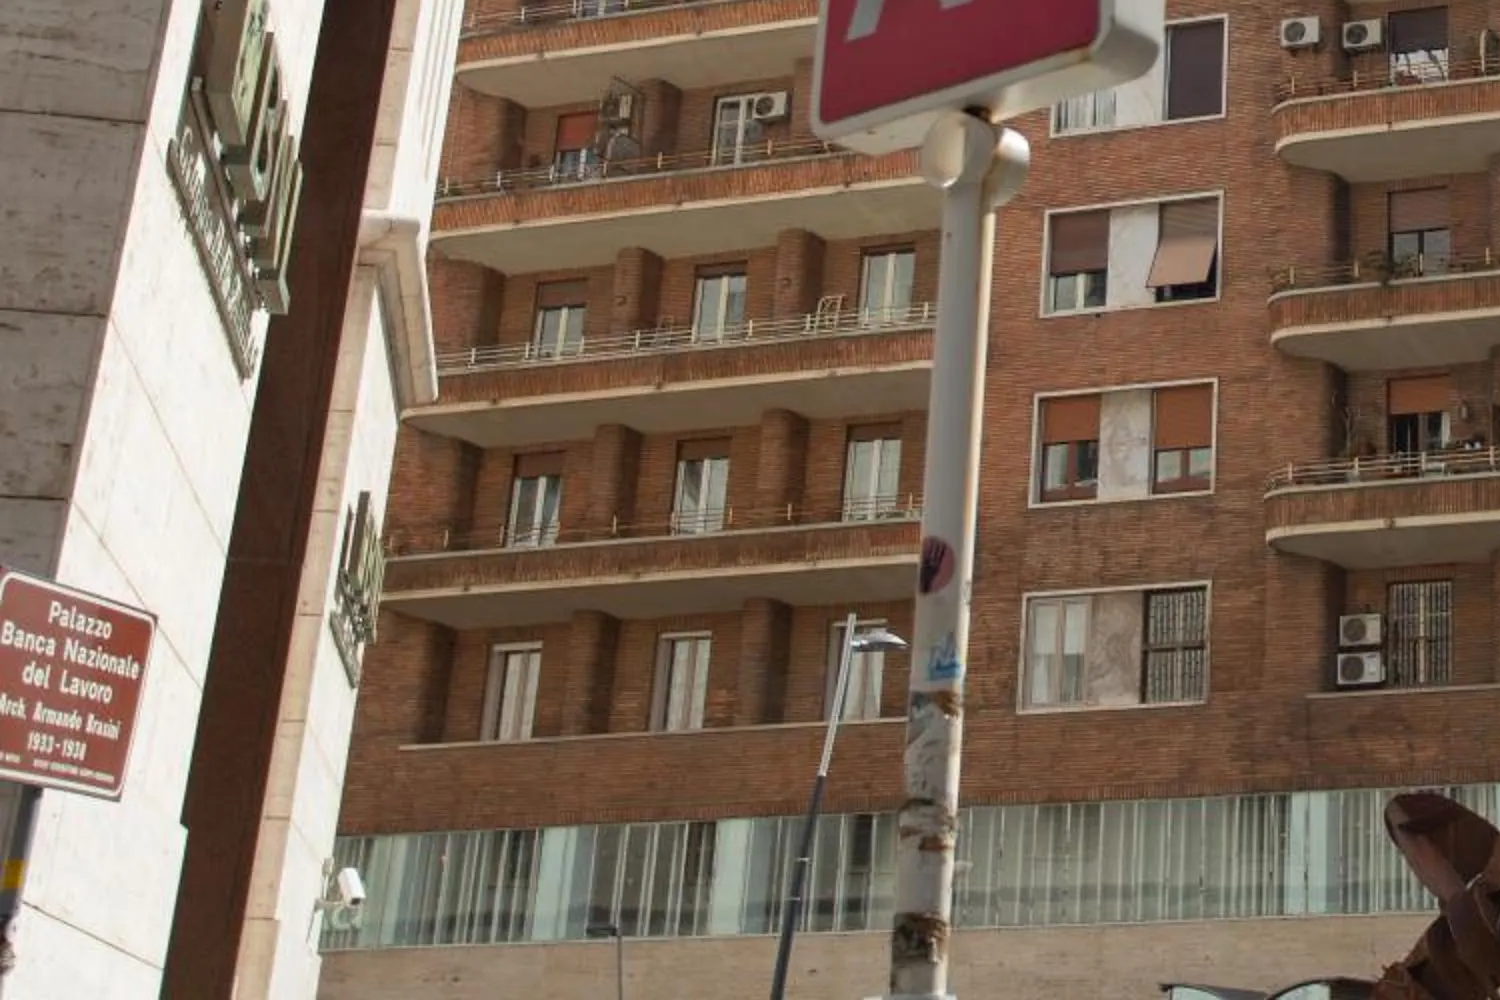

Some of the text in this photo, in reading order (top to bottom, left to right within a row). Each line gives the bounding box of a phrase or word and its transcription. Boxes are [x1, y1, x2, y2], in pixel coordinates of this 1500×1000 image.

[48, 601, 113, 640] Palazzo
[1, 621, 140, 679] Banca Nazionale
[22, 661, 113, 703] del Lavoro
[33, 701, 82, 731] Armando
